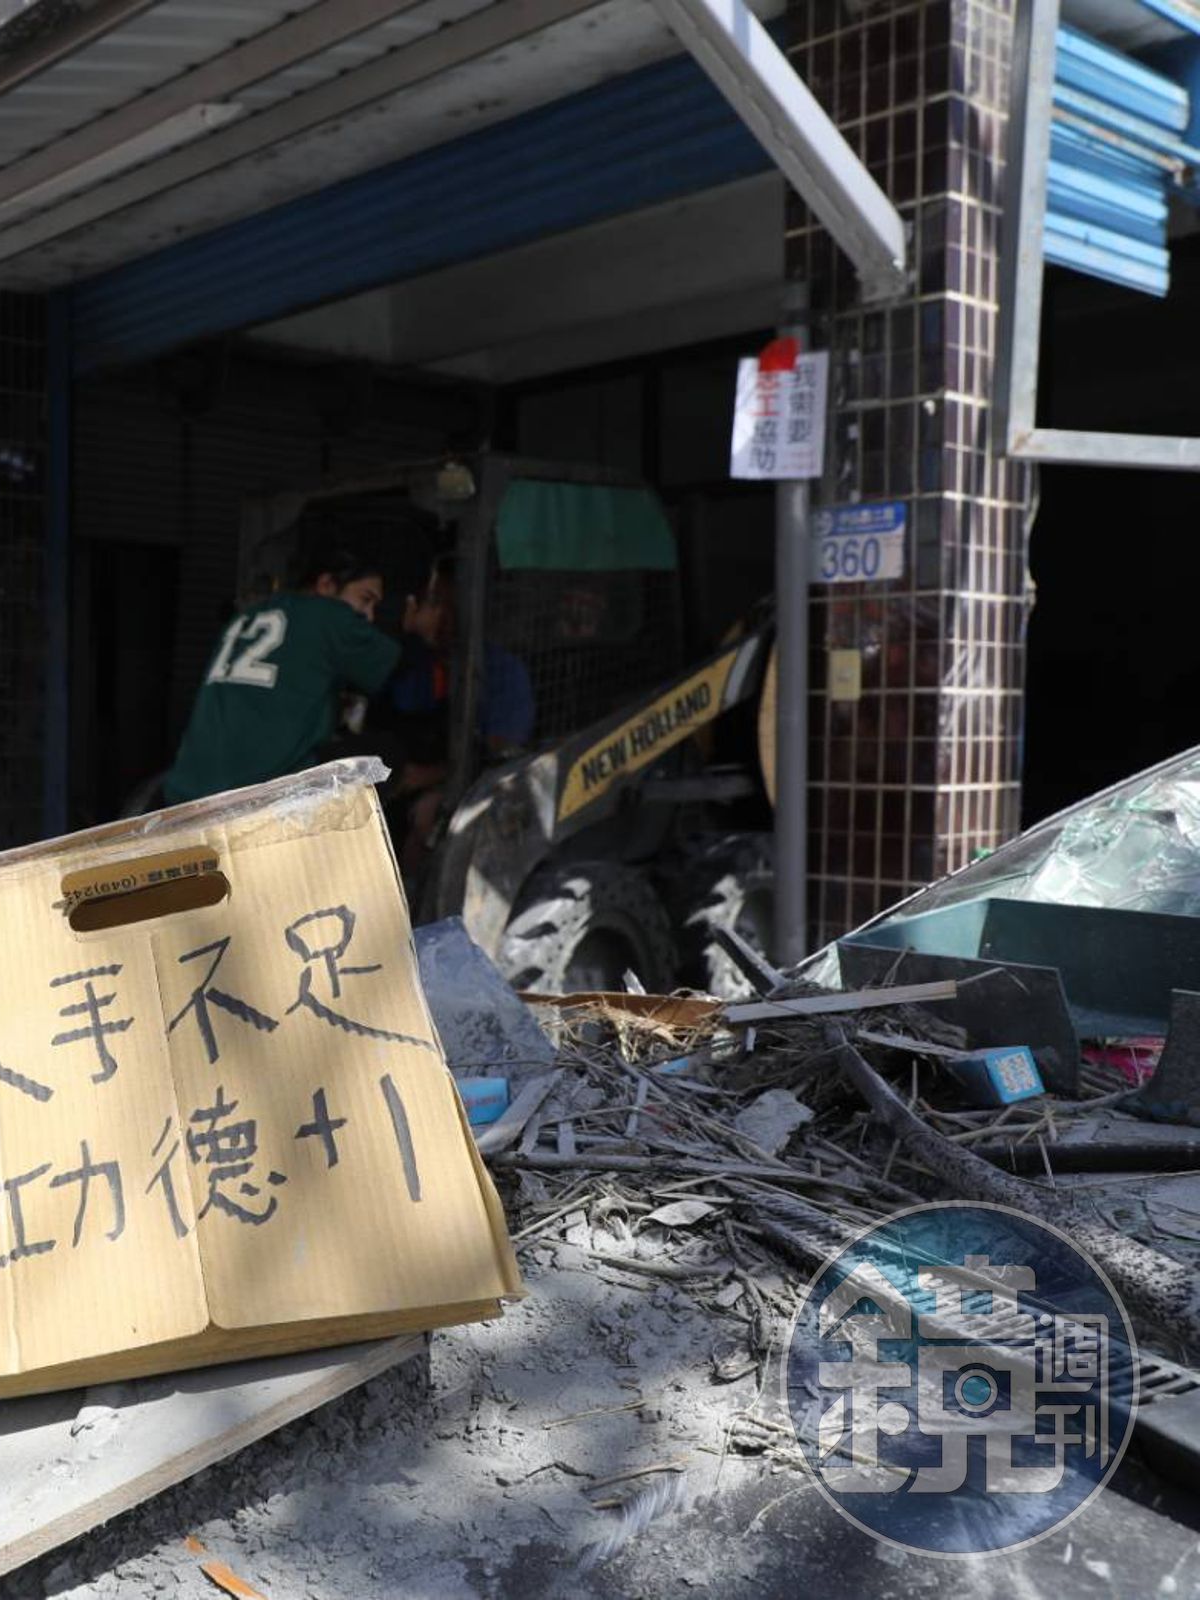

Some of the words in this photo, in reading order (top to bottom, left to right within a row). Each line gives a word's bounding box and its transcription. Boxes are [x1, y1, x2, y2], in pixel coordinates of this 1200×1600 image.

[820, 537, 881, 579] 360
[206, 607, 288, 690] 12
[580, 737, 627, 790] NEW
[629, 680, 713, 757] HOLLAND
